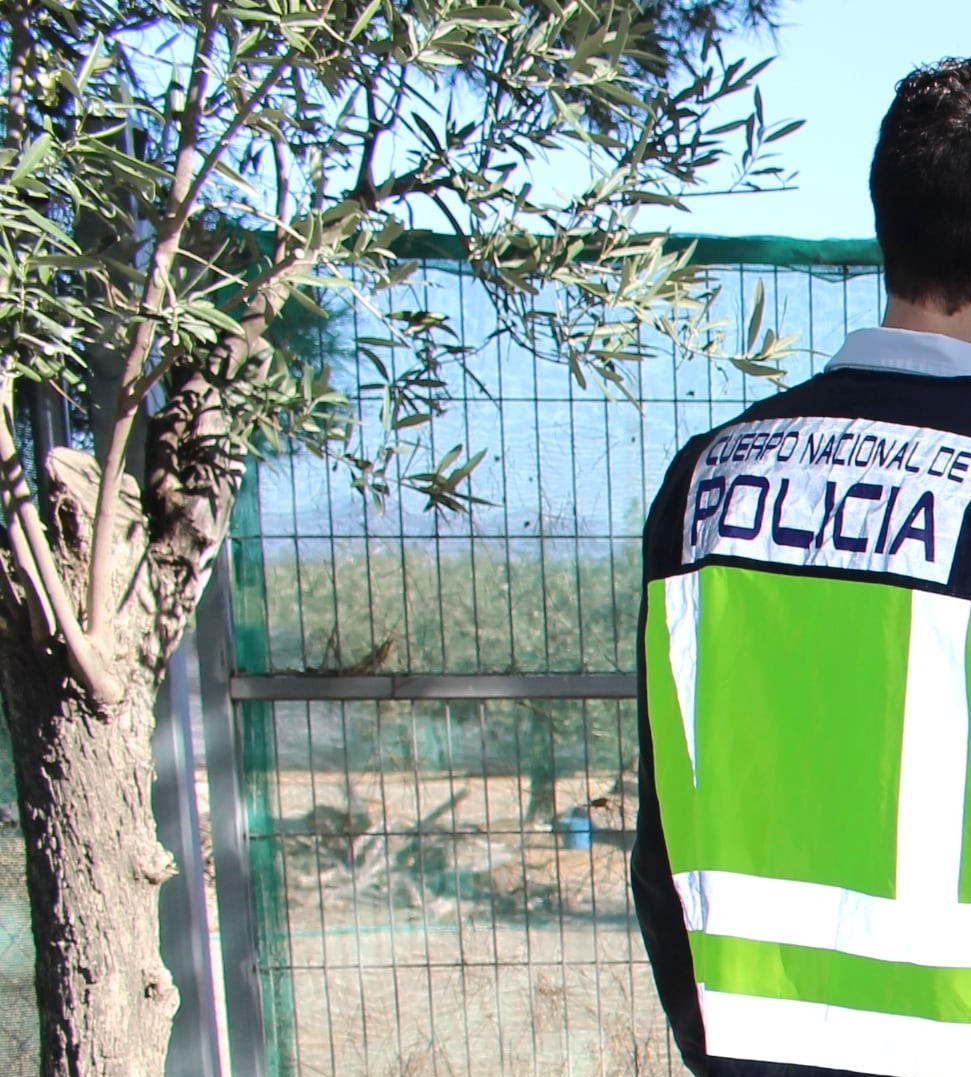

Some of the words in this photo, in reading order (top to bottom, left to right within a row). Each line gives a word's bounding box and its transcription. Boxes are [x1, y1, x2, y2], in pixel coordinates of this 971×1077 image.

[705, 431, 799, 467] CUERPO
[799, 432, 920, 474] NACIONAL
[690, 474, 936, 563] POLICIA
